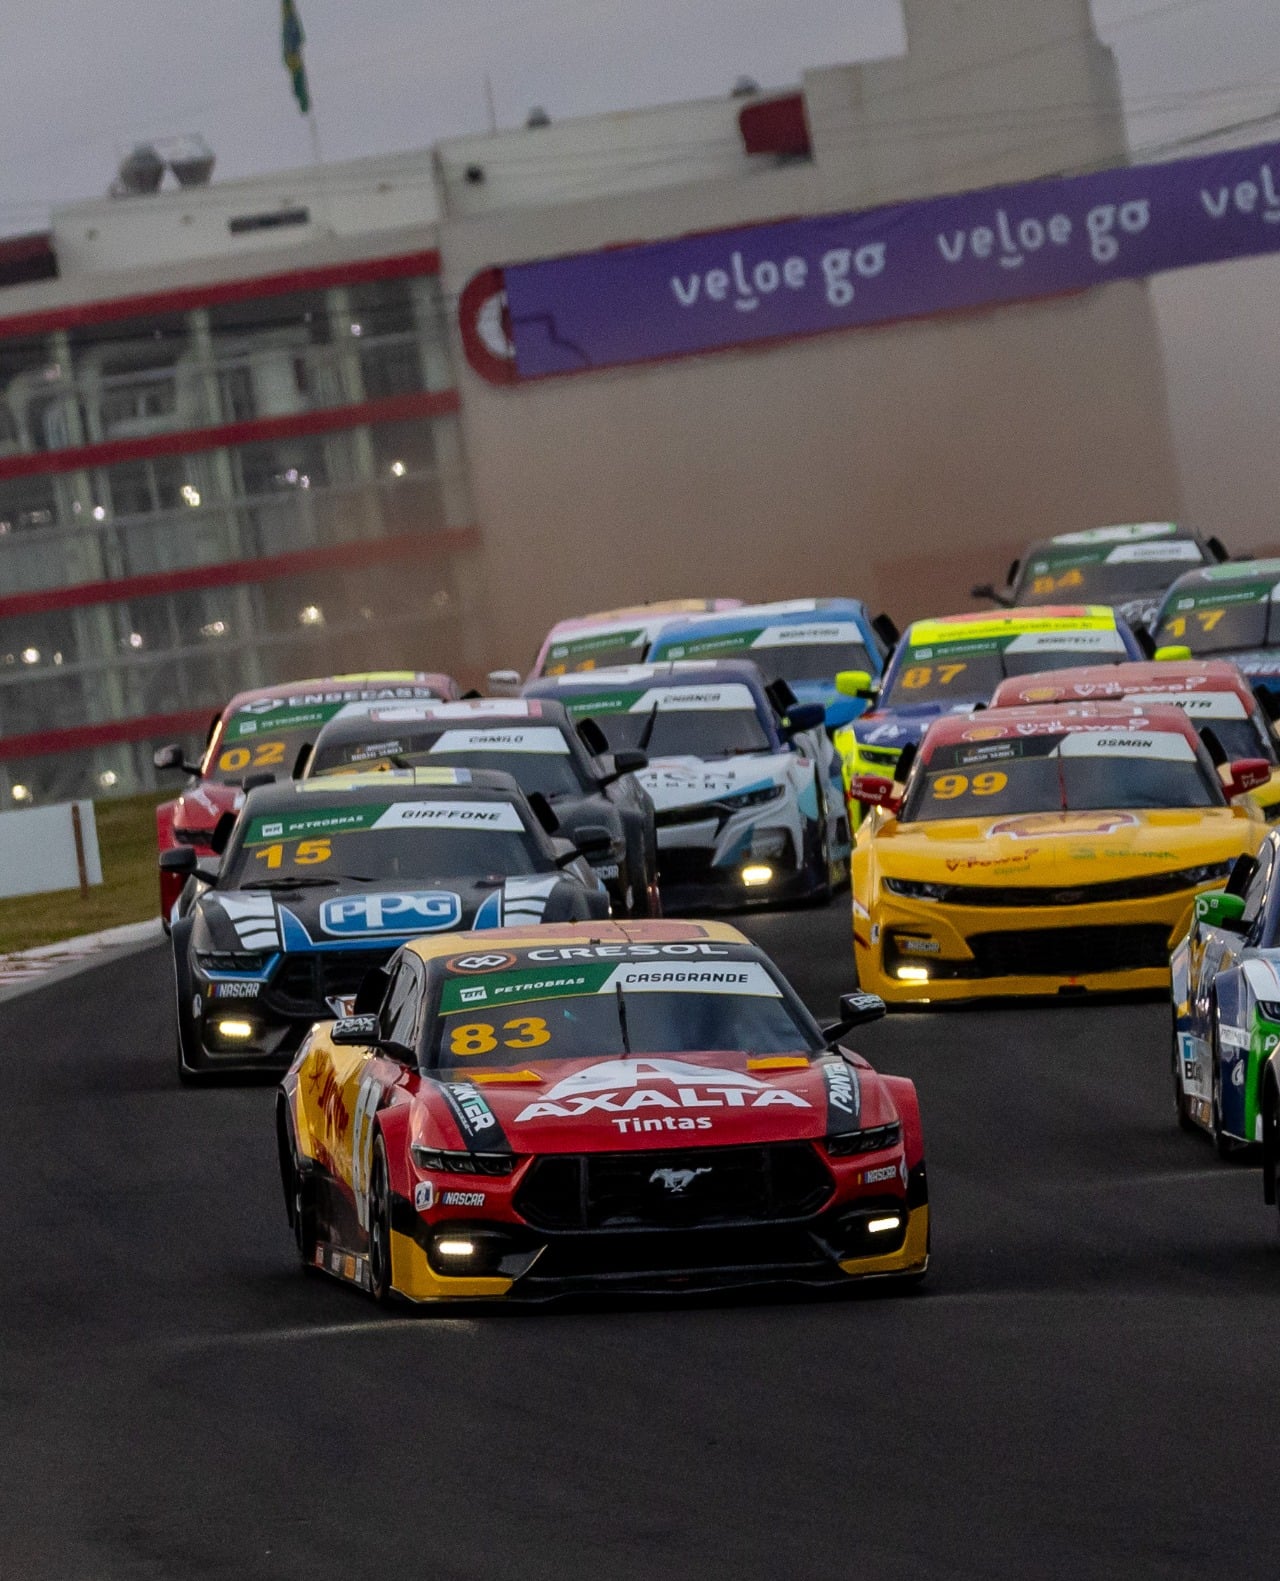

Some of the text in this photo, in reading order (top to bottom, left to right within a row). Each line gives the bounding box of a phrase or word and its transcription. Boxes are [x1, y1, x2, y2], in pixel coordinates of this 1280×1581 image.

[937, 201, 1151, 268] veloe go
[671, 241, 887, 311] veloe go
[902, 663, 968, 689] 87
[1171, 700, 1213, 709] NTA
[1096, 738, 1153, 748] OSMAN
[218, 742, 286, 772] 02
[932, 771, 1008, 800] 99
[289, 814, 364, 831] PETROBRAS
[401, 809, 502, 822] GIAFFONE
[255, 838, 332, 869] 15
[331, 893, 451, 928] PPG
[527, 944, 729, 962] CRESOL
[494, 977, 585, 995] PETROBRAS
[625, 972, 749, 984] CASAGRANDE
[220, 982, 260, 998] NASCAR
[450, 1016, 551, 1056] 83
[514, 1088, 812, 1122] AXALTA
[612, 1116, 713, 1134] Tintas
[446, 1192, 485, 1207] NASCAR
